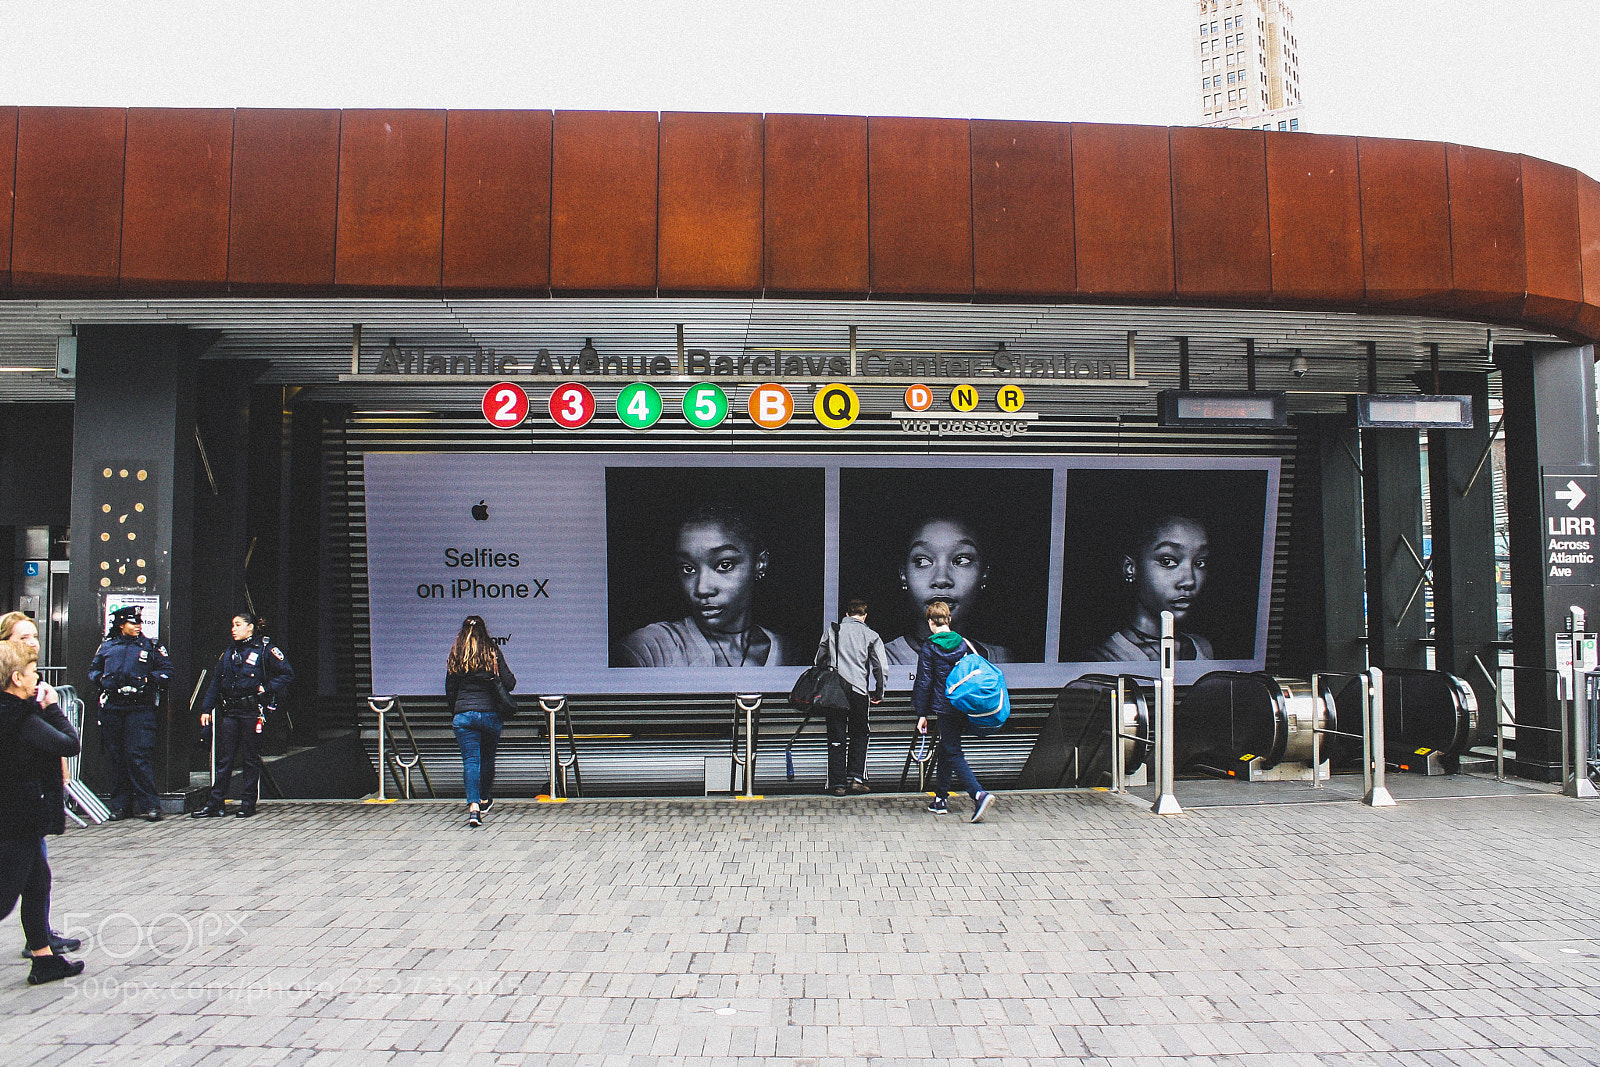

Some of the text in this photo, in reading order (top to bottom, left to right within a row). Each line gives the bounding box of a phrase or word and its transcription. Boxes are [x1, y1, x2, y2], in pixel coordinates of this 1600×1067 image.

[375, 347, 1117, 388] Atlantic Avenue Barclays Center Station
[495, 389, 852, 421] 2 3 4 5 B Q
[911, 389, 1019, 408] D N R
[901, 418, 1029, 437] via passage
[1548, 517, 1595, 536] LIRR
[1548, 538, 1590, 550] Across
[444, 548, 520, 567] Selfies
[1549, 552, 1594, 564] Atlantic
[1549, 566, 1572, 577] Ave
[416, 578, 549, 599] on iPhone X
